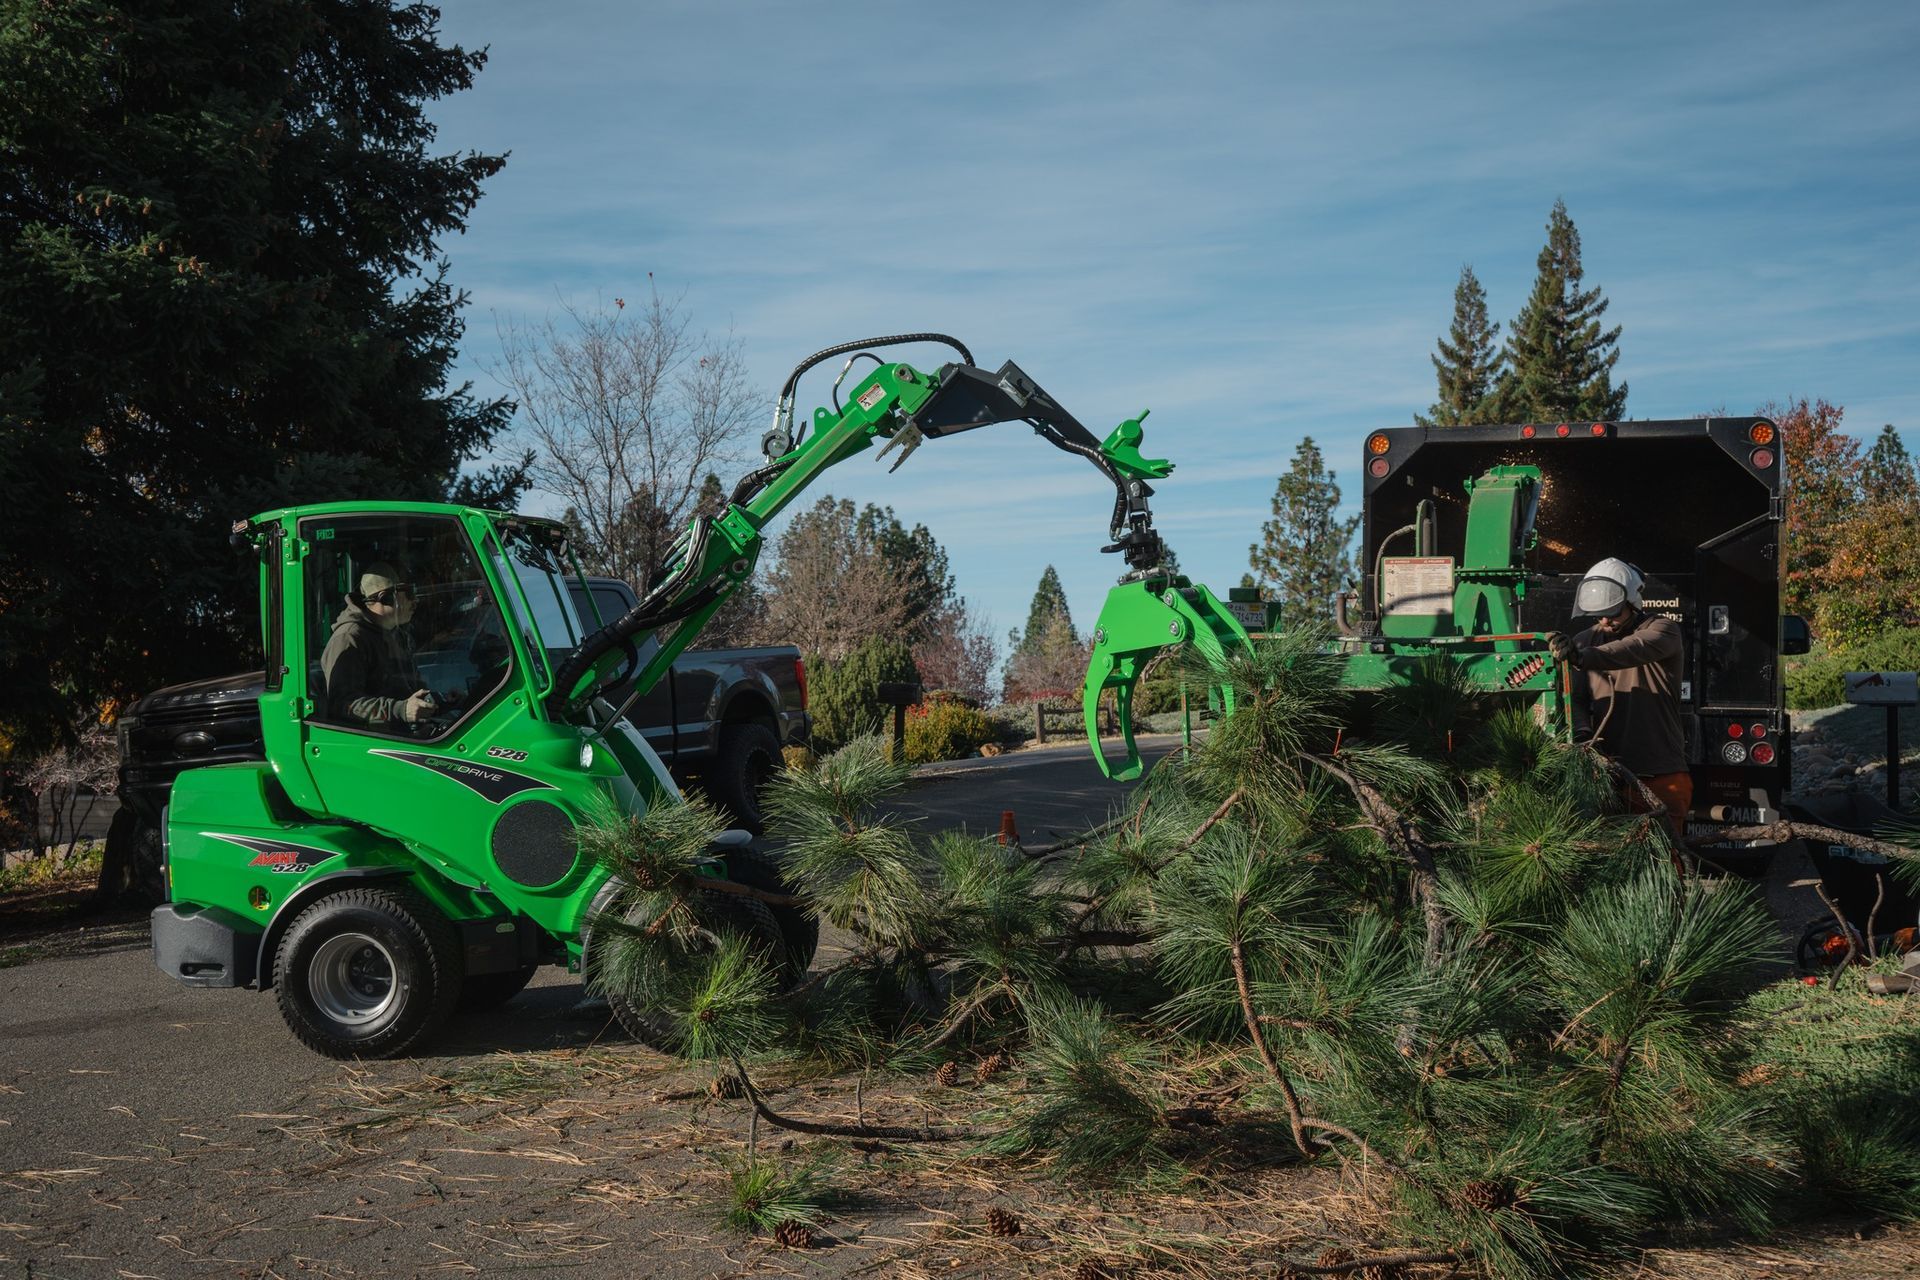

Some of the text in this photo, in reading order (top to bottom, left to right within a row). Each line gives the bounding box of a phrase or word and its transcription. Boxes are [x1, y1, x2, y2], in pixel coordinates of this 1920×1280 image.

[1641, 597, 1680, 608] emoval
[1232, 612, 1264, 623] 714733
[486, 745, 529, 762] 528
[424, 757, 503, 782] OPTIDRIVE
[1727, 807, 1766, 823] MART
[248, 851, 300, 866] AVANT
[271, 863, 309, 874] 528
